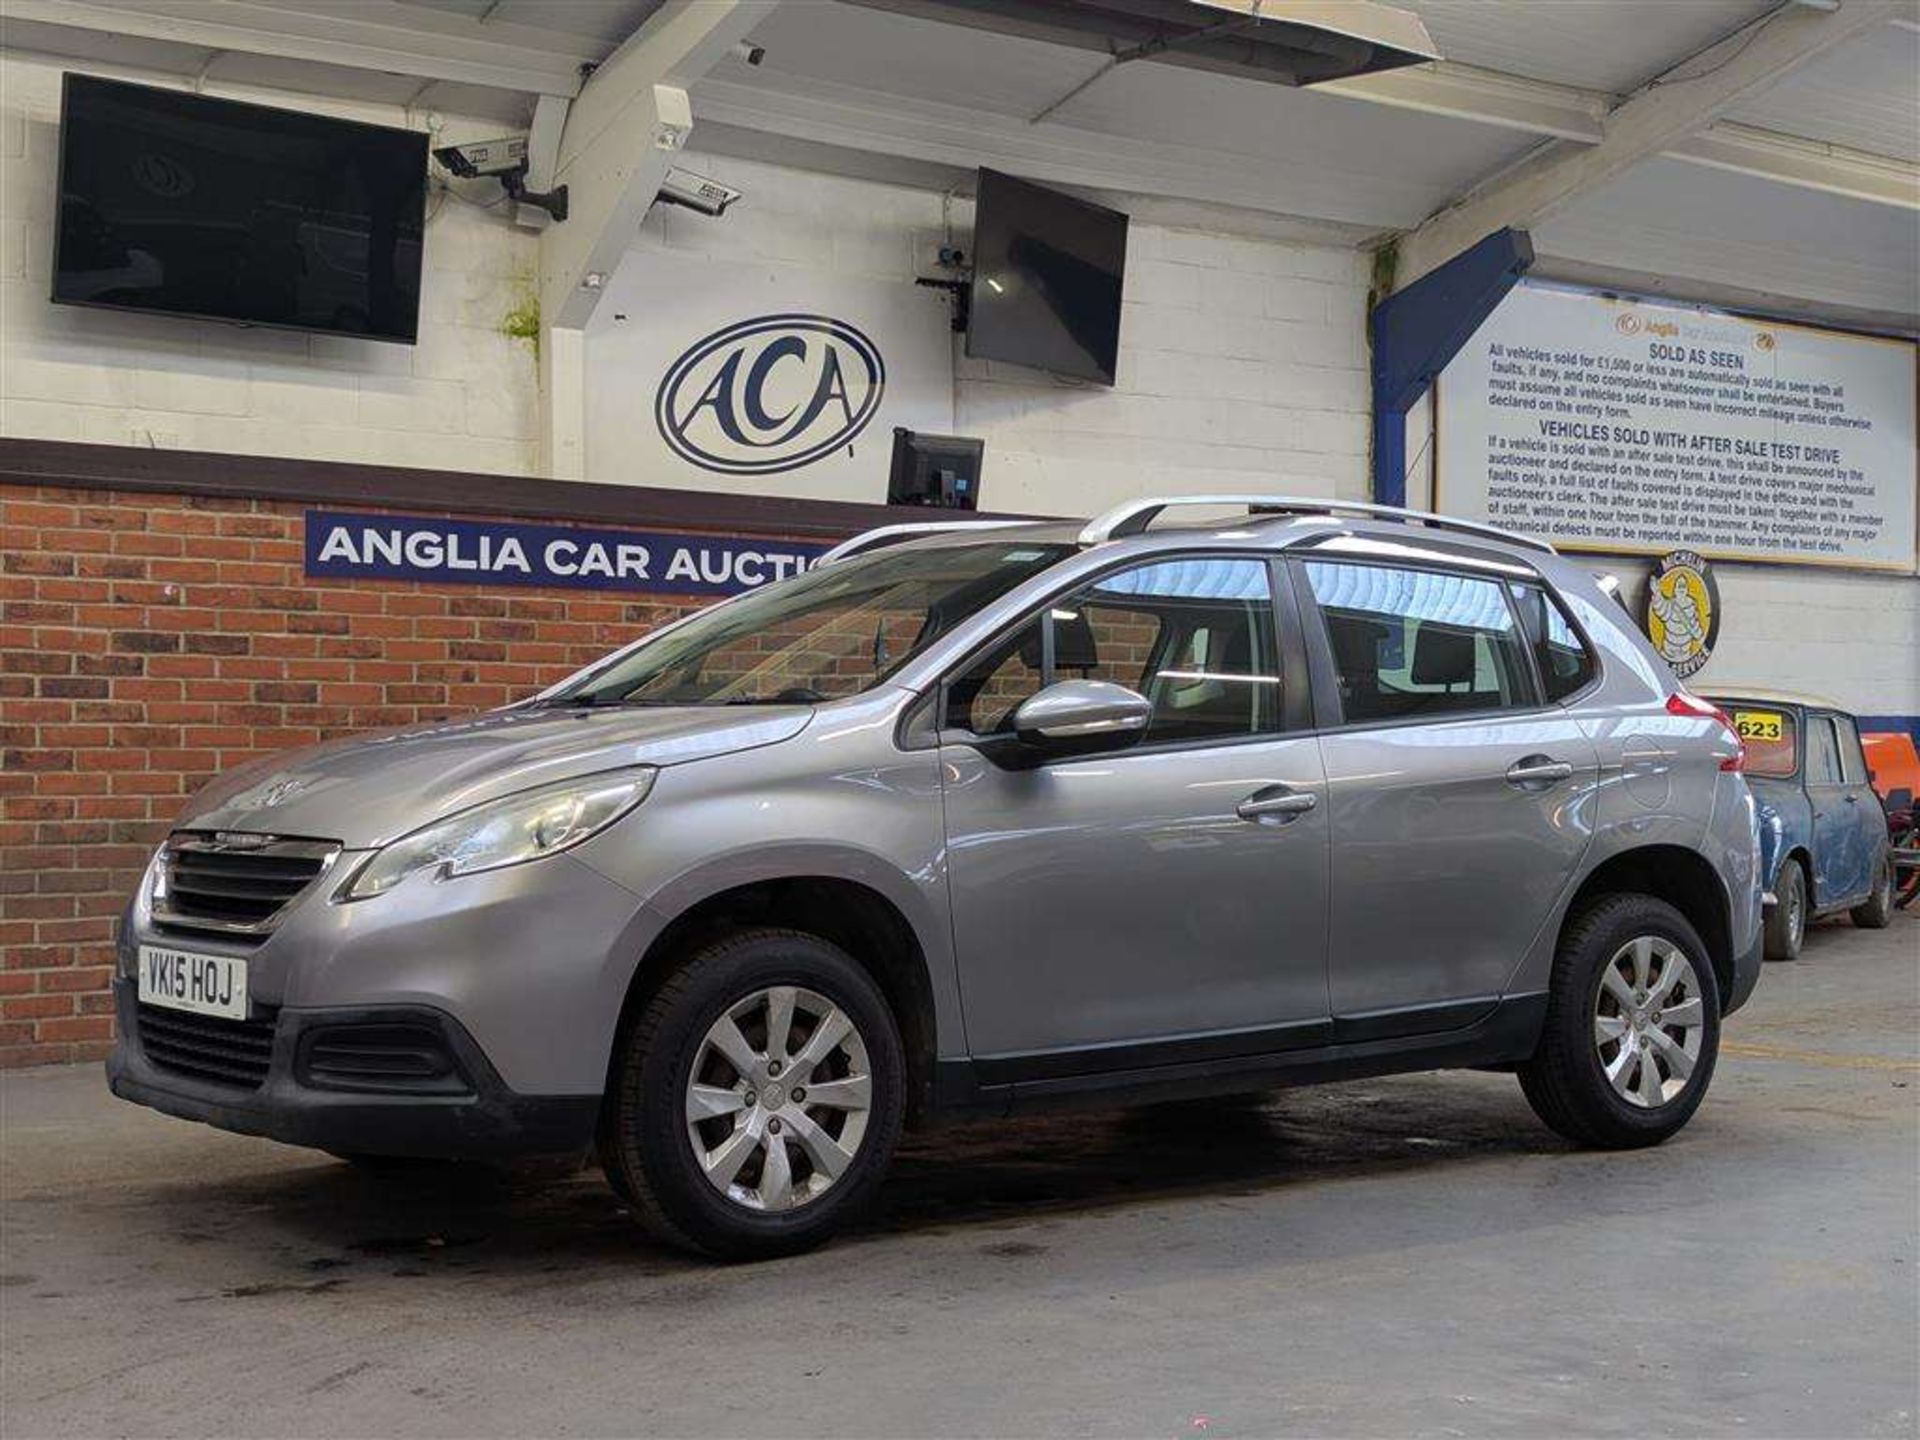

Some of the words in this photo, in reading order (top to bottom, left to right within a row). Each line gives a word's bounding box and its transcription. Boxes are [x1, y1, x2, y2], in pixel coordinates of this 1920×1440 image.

[1488, 344, 1503, 357] All
[1505, 348, 1551, 363] vehicles
[1553, 354, 1577, 366] sold
[1579, 355, 1595, 368] for
[1597, 357, 1630, 372] £1,500
[1632, 364, 1643, 373] or
[1645, 363, 1666, 376] less
[1668, 368, 1685, 378] are
[1687, 369, 1750, 388] automatically
[1751, 377, 1772, 388] sold
[1774, 380, 1786, 390] as
[1788, 382, 1810, 393] seen
[1812, 384, 1830, 395] with
[1832, 386, 1842, 397] all
[1649, 343, 1685, 362] SOLD
[1688, 348, 1706, 365] AS
[1709, 350, 1743, 369] SEEN
[678, 336, 850, 446] ACA
[1488, 380, 1516, 391] must
[1518, 383, 1561, 396] assume
[1563, 386, 1576, 397] all
[1578, 389, 1622, 402] vehicles
[1625, 394, 1646, 405] sold
[1648, 397, 1660, 406] as
[1662, 399, 1686, 409] seen
[1688, 399, 1711, 412] have
[1713, 402, 1757, 417] incorrect
[1758, 408, 1794, 423] mileage
[1796, 412, 1826, 424] unless
[1828, 415, 1871, 429] otherwise
[1488, 393, 1536, 409] declared
[1538, 401, 1552, 410] on
[1555, 400, 1572, 412] the
[1575, 404, 1602, 418] entry
[1605, 405, 1631, 418] form.
[1528, 365, 1536, 377] if
[1562, 371, 1583, 382] and
[1585, 374, 1599, 384] no
[1601, 376, 1657, 390] complaints
[1658, 381, 1715, 397] whatsoever
[1717, 388, 1740, 400] shall
[1742, 390, 1754, 401] be
[1813, 398, 1844, 412] Buyers
[1488, 435, 1496, 447] If
[1498, 439, 1506, 448] a
[1508, 438, 1546, 452] vehicle
[1549, 441, 1559, 453] is
[1561, 443, 1585, 455] sold
[1587, 445, 1610, 457] with
[1612, 449, 1625, 459] an
[1627, 449, 1651, 461] after
[1653, 452, 1673, 463] sale
[1675, 453, 1694, 465] test
[1726, 457, 1744, 469] this
[1746, 460, 1769, 472] shall
[1771, 462, 1783, 473] be
[1785, 465, 1834, 477] announced
[1836, 468, 1847, 481] by
[1849, 469, 1863, 480] the
[1539, 419, 1609, 442] VEHICLES
[1613, 426, 1649, 446] SOLD
[1653, 430, 1686, 449] WITH
[1690, 434, 1731, 453] AFTER
[1734, 438, 1767, 457] SALE
[1770, 442, 1800, 460] TEST
[1804, 445, 1839, 464] DRIVE
[1488, 454, 1546, 468] auctioneer
[1548, 458, 1568, 470] and
[1571, 459, 1617, 474] declared
[1619, 466, 1632, 475] on
[1634, 465, 1650, 476] the
[1652, 467, 1678, 482] entry
[1680, 469, 1706, 481] form.
[1708, 471, 1716, 482] A
[1717, 472, 1736, 484] test
[1738, 474, 1762, 486] drive
[1764, 478, 1796, 489] covers
[1798, 480, 1823, 493] major
[1825, 483, 1874, 495] mechanical
[1488, 468, 1519, 481] faults
[1521, 472, 1548, 486] only,
[1549, 475, 1556, 484] a
[1559, 474, 1576, 486] full
[1578, 475, 1595, 488] list
[1597, 478, 1608, 489] of
[1611, 478, 1639, 491] faults
[1641, 483, 1681, 494] covered
[1683, 484, 1692, 495] is
[1694, 485, 1741, 501] displayed
[1743, 489, 1752, 500] in
[1754, 490, 1769, 502] the
[1771, 492, 1798, 504] office
[1799, 495, 1816, 505] and
[1818, 496, 1837, 507] with
[1839, 497, 1853, 508] the
[1487, 486, 1554, 500] auctioneer's
[1556, 490, 1586, 503] clerk.
[1588, 492, 1608, 504] The
[1610, 494, 1634, 506] after
[1636, 497, 1657, 508] sale
[1659, 498, 1678, 510] test
[1680, 499, 1705, 512] drive
[1707, 503, 1732, 514] must
[1734, 504, 1746, 515] be
[1779, 507, 1817, 521] together
[1820, 511, 1838, 522] with
[1840, 514, 1846, 522] a
[1848, 514, 1883, 525] member
[1487, 501, 1499, 512] of
[1531, 505, 1564, 517] within
[1566, 509, 1587, 519] one
[1589, 508, 1614, 521] hour
[1616, 510, 1639, 522] from
[1642, 512, 1658, 524] the
[1660, 513, 1676, 525] fall
[1678, 515, 1688, 526] of
[1690, 516, 1706, 527] the
[1750, 520, 1769, 534] Any
[1771, 523, 1821, 536] complaints
[1822, 526, 1832, 536] of
[1834, 528, 1850, 540] any
[1851, 528, 1877, 541] major
[318, 527, 531, 572] ANGLIA
[544, 540, 650, 579] CAR
[664, 549, 819, 586] AUCTI
[1487, 519, 1550, 533] mechanical
[1551, 521, 1591, 535] defects
[1594, 526, 1620, 537] must
[1622, 526, 1635, 538] be
[1637, 529, 1680, 542] reported
[1682, 531, 1711, 543] within
[1714, 535, 1732, 544] one
[1734, 534, 1756, 546] hour
[1758, 536, 1780, 548] from
[1782, 537, 1796, 549] the
[1799, 538, 1816, 550] test
[1818, 540, 1843, 552] drive.
[1738, 721, 1780, 738] 623
[149, 952, 186, 998] VK15
[192, 958, 231, 1006] HOJ
